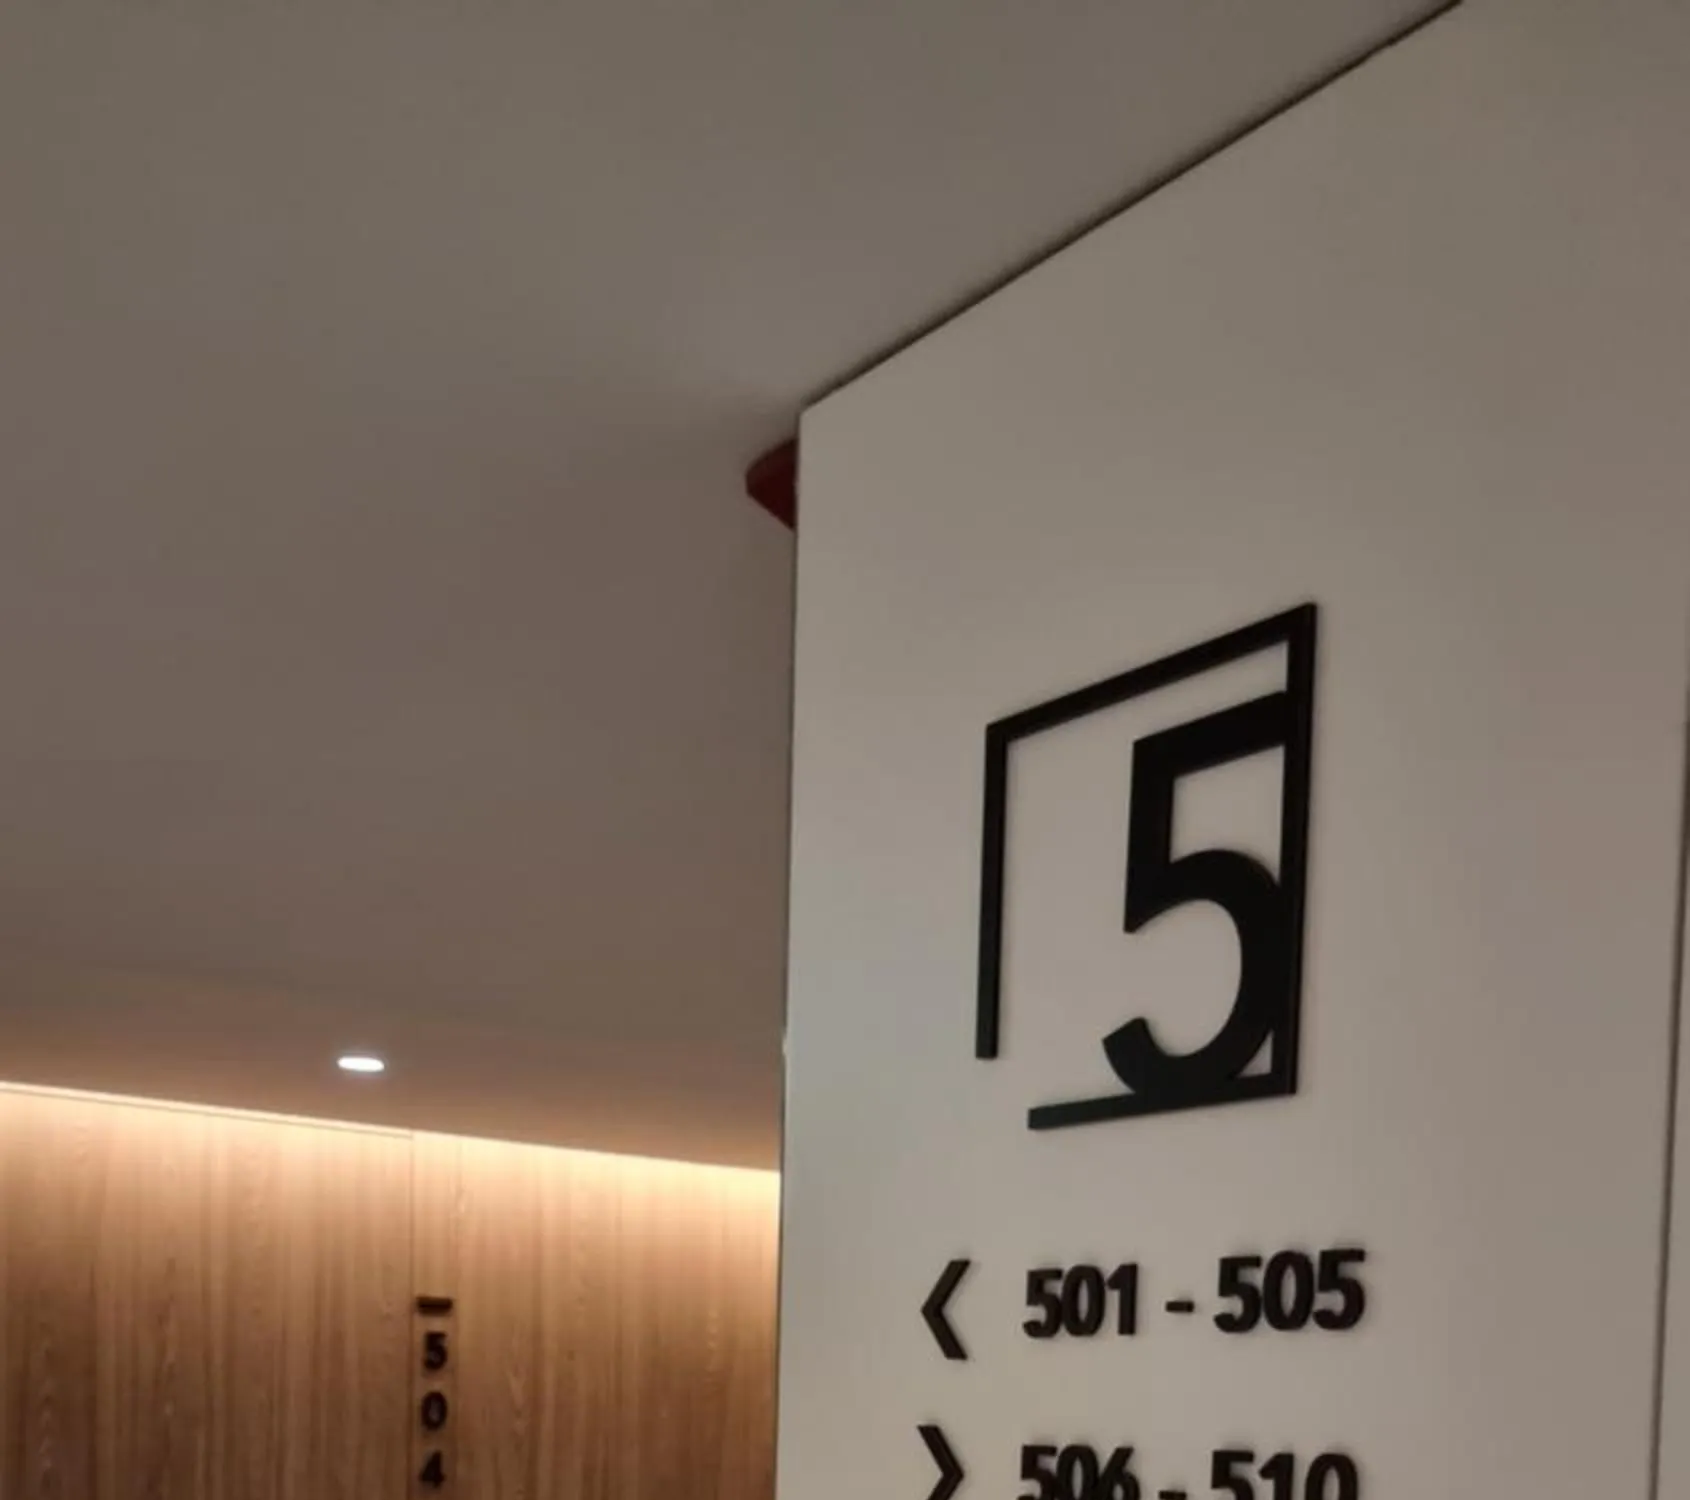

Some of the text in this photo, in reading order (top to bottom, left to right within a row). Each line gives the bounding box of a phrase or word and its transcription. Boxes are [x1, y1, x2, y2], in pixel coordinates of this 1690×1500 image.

[1102, 690, 1300, 1105] 5
[1022, 1262, 1139, 1339] 501
[1213, 1247, 1367, 1334] 505
[420, 1332, 448, 1489] 504
